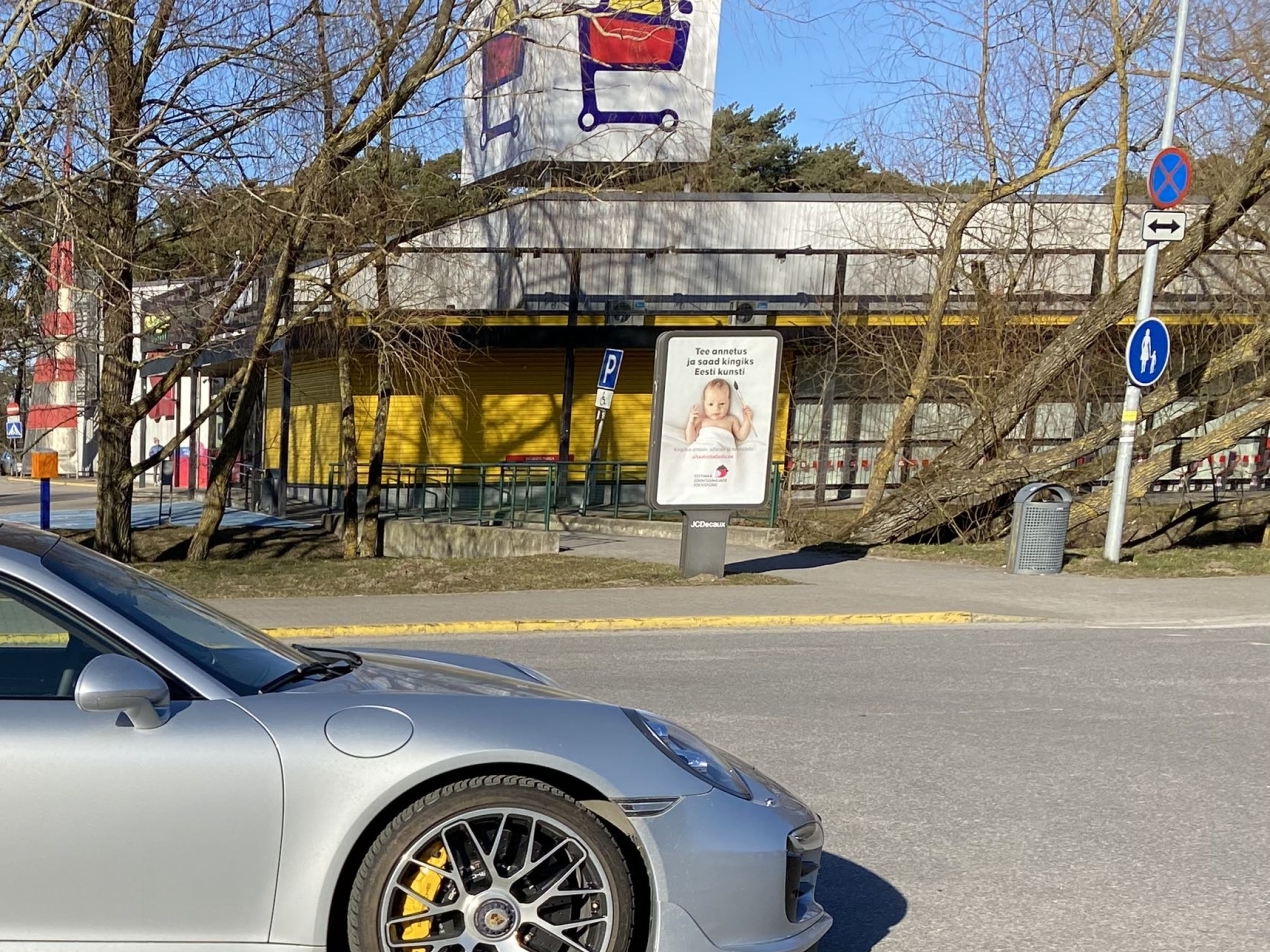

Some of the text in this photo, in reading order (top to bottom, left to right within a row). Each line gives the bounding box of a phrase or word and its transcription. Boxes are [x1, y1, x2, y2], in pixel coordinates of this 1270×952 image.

[695, 347, 748, 355] Tee annetus
[686, 358, 754, 367] ja saad kingiks
[602, 353, 617, 384] P
[694, 367, 746, 376] Eesti kunsti
[690, 520, 726, 528] JCDecaux
